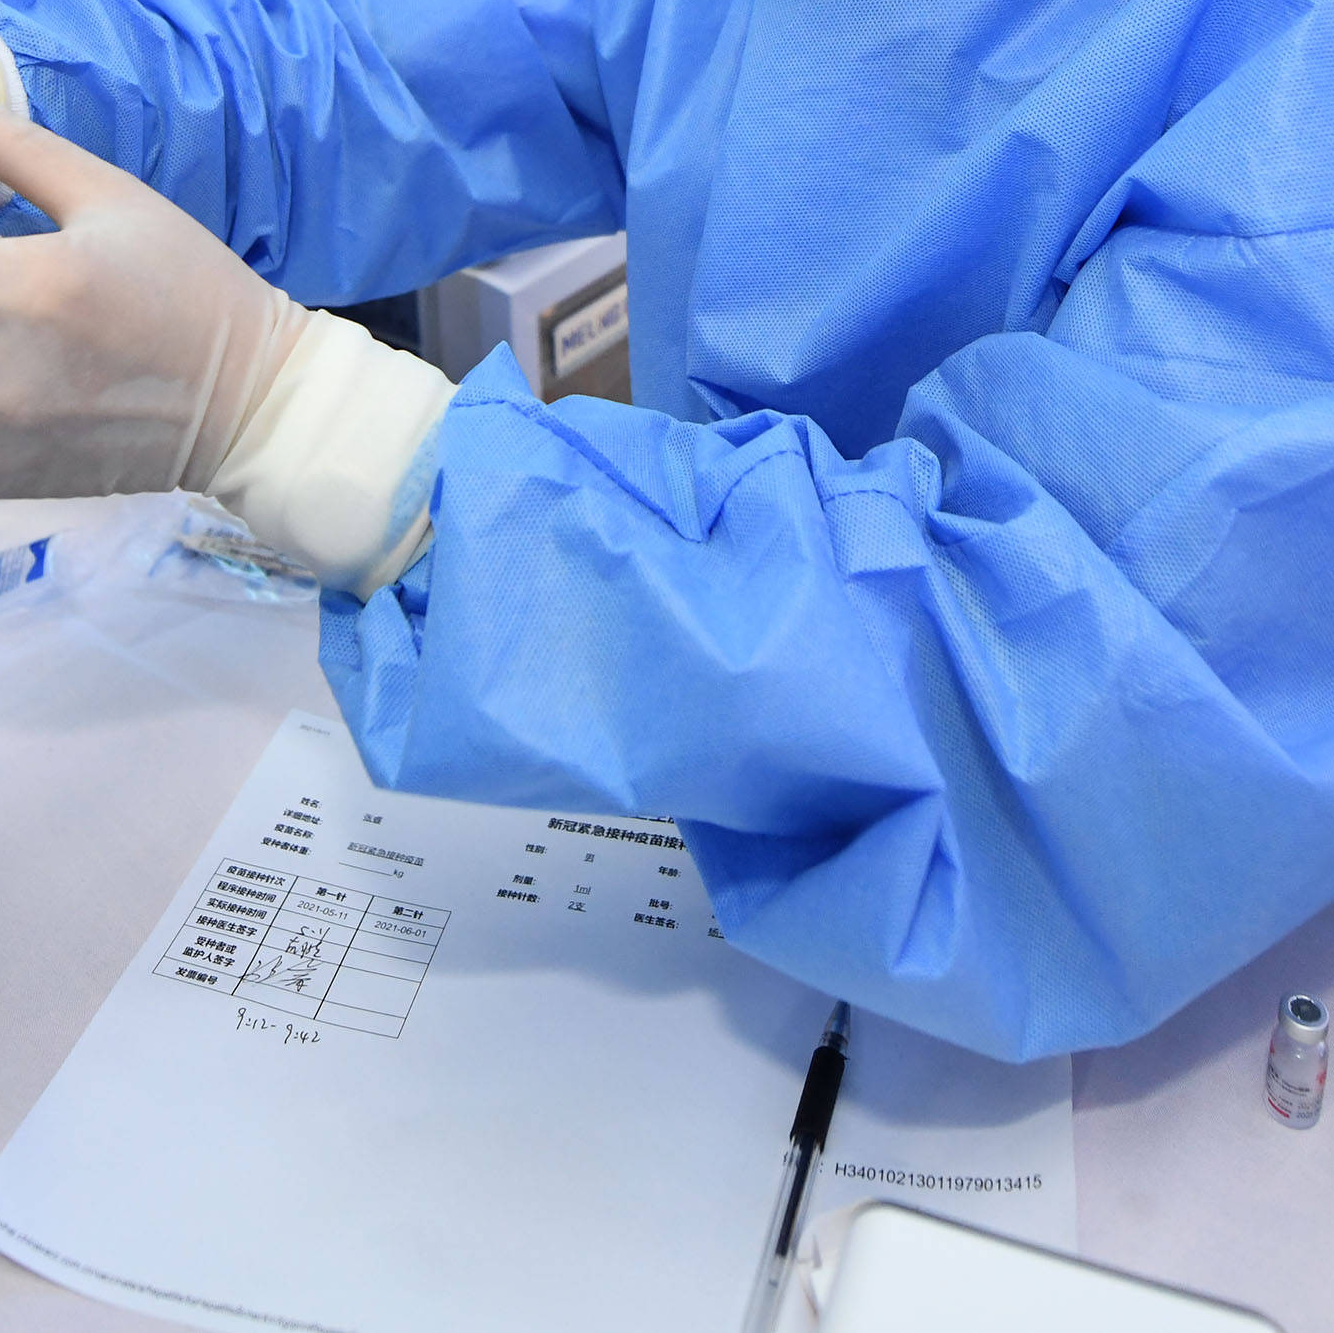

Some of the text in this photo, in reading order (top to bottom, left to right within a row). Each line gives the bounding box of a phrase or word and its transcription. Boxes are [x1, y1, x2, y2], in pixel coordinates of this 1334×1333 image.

[583, 853, 595, 864] 男
[227, 866, 286, 887] 疫苗接种针次
[393, 868, 405, 879] kg
[217, 880, 277, 903] 程序接种时间
[316, 886, 348, 902] 第一针
[207, 897, 267, 920] 实际接种时间
[297, 900, 349, 921] 2021-05-11
[392, 905, 424, 920] 第二针
[196, 914, 258, 937] 接种医生签字
[374, 920, 427, 938] 2021-06-01
[634, 912, 681, 930] 医生签名:
[195, 935, 237, 955] 受种者或
[182, 946, 236, 968] 监护人签字
[175, 966, 218, 986] 发票编号
